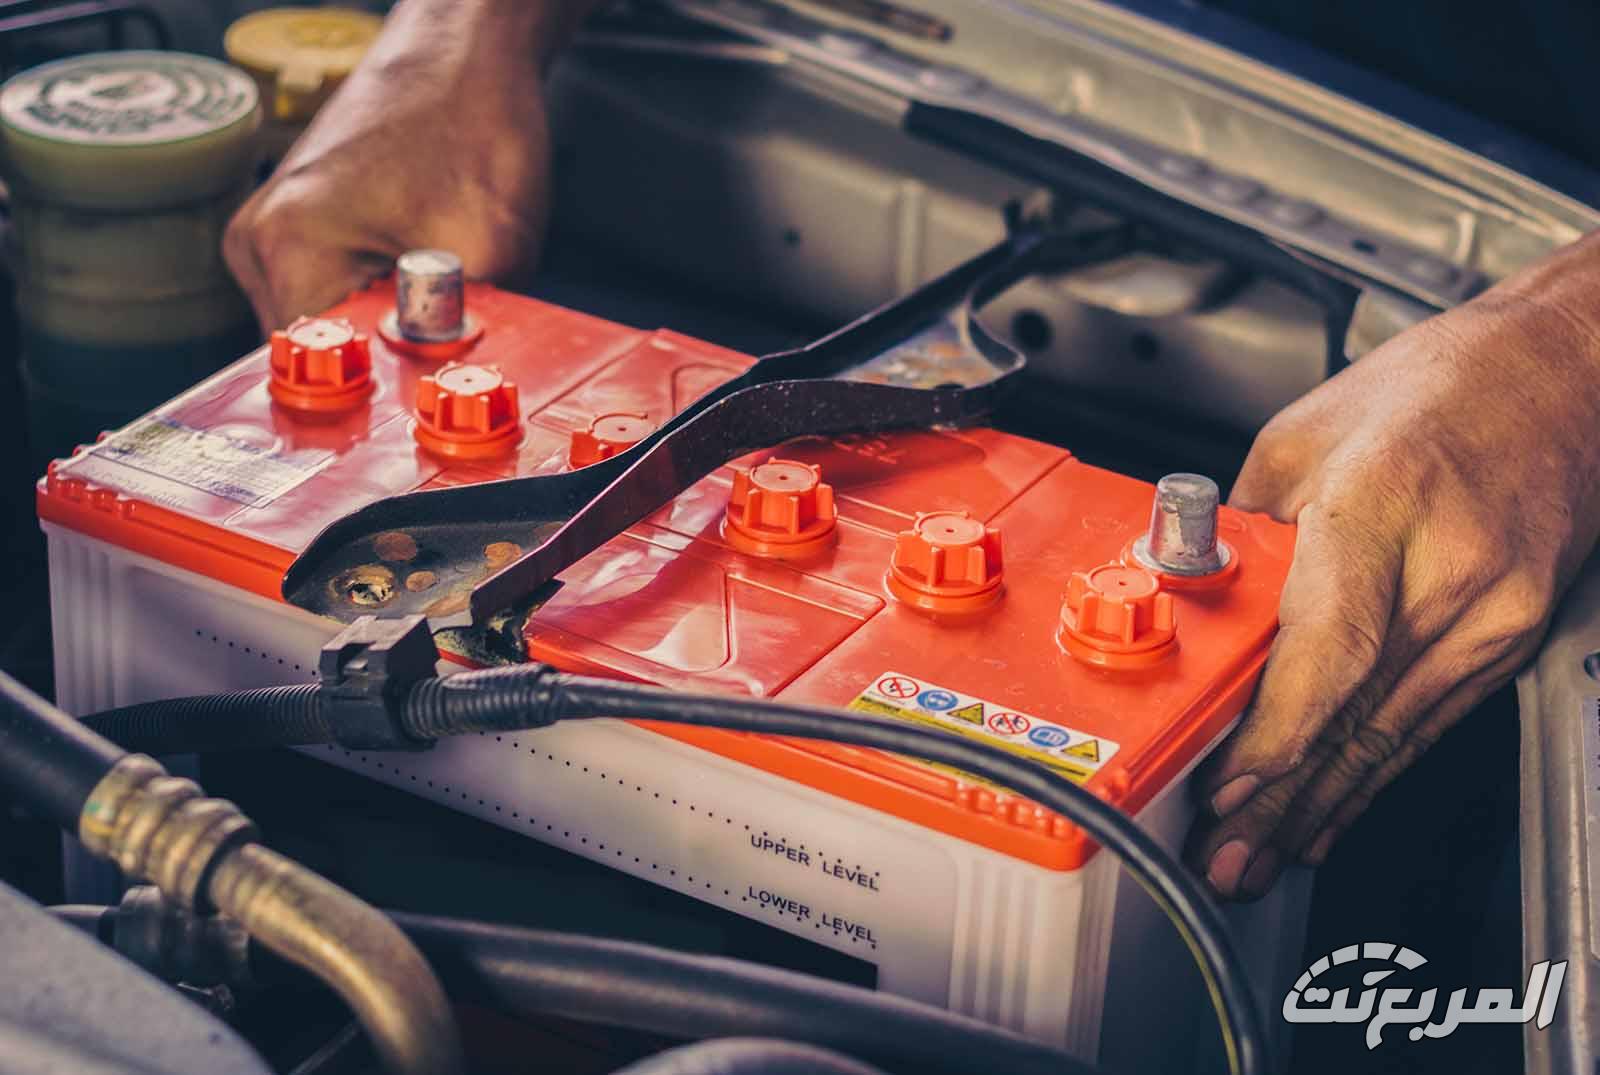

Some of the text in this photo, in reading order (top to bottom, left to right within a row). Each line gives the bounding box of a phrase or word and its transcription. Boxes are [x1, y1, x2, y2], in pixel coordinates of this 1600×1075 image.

[751, 834, 879, 891] UPPER LEVEL
[749, 886, 876, 943] LOWER LEVEL
